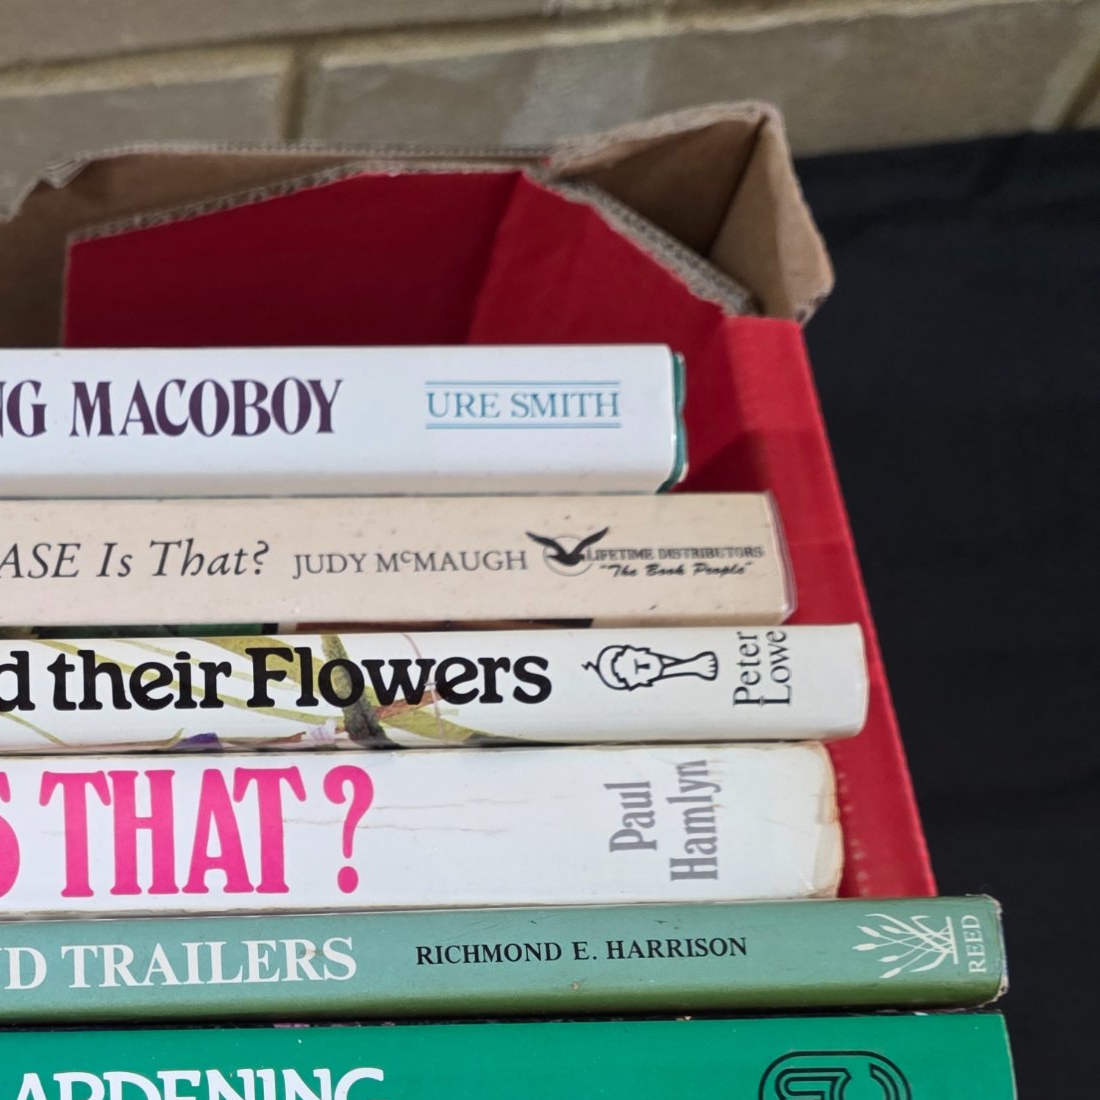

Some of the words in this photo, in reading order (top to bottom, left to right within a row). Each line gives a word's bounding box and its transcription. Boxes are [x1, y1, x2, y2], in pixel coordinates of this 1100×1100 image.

[69, 376, 343, 437] MACOBOY
[426, 393, 500, 419] URE
[510, 391, 620, 418] SMITH
[96, 541, 133, 579] Is
[148, 537, 270, 578] That?
[292, 553, 367, 579] JUDY
[646, 563, 685, 576] Book
[658, 545, 764, 559] DISTRIBUTORS
[49, 651, 231, 711] their
[246, 647, 552, 708] Flowers
[732, 631, 761, 707] Peter
[760, 630, 792, 707] Lowe
[604, 781, 658, 852] Paul
[666, 760, 718, 882] Hamlyn
[61, 937, 358, 989] TRAILERS
[416, 940, 561, 966] RICHMOND
[573, 940, 598, 962] E.
[606, 936, 748, 961] HARRISON
[967, 913, 990, 975] REED
